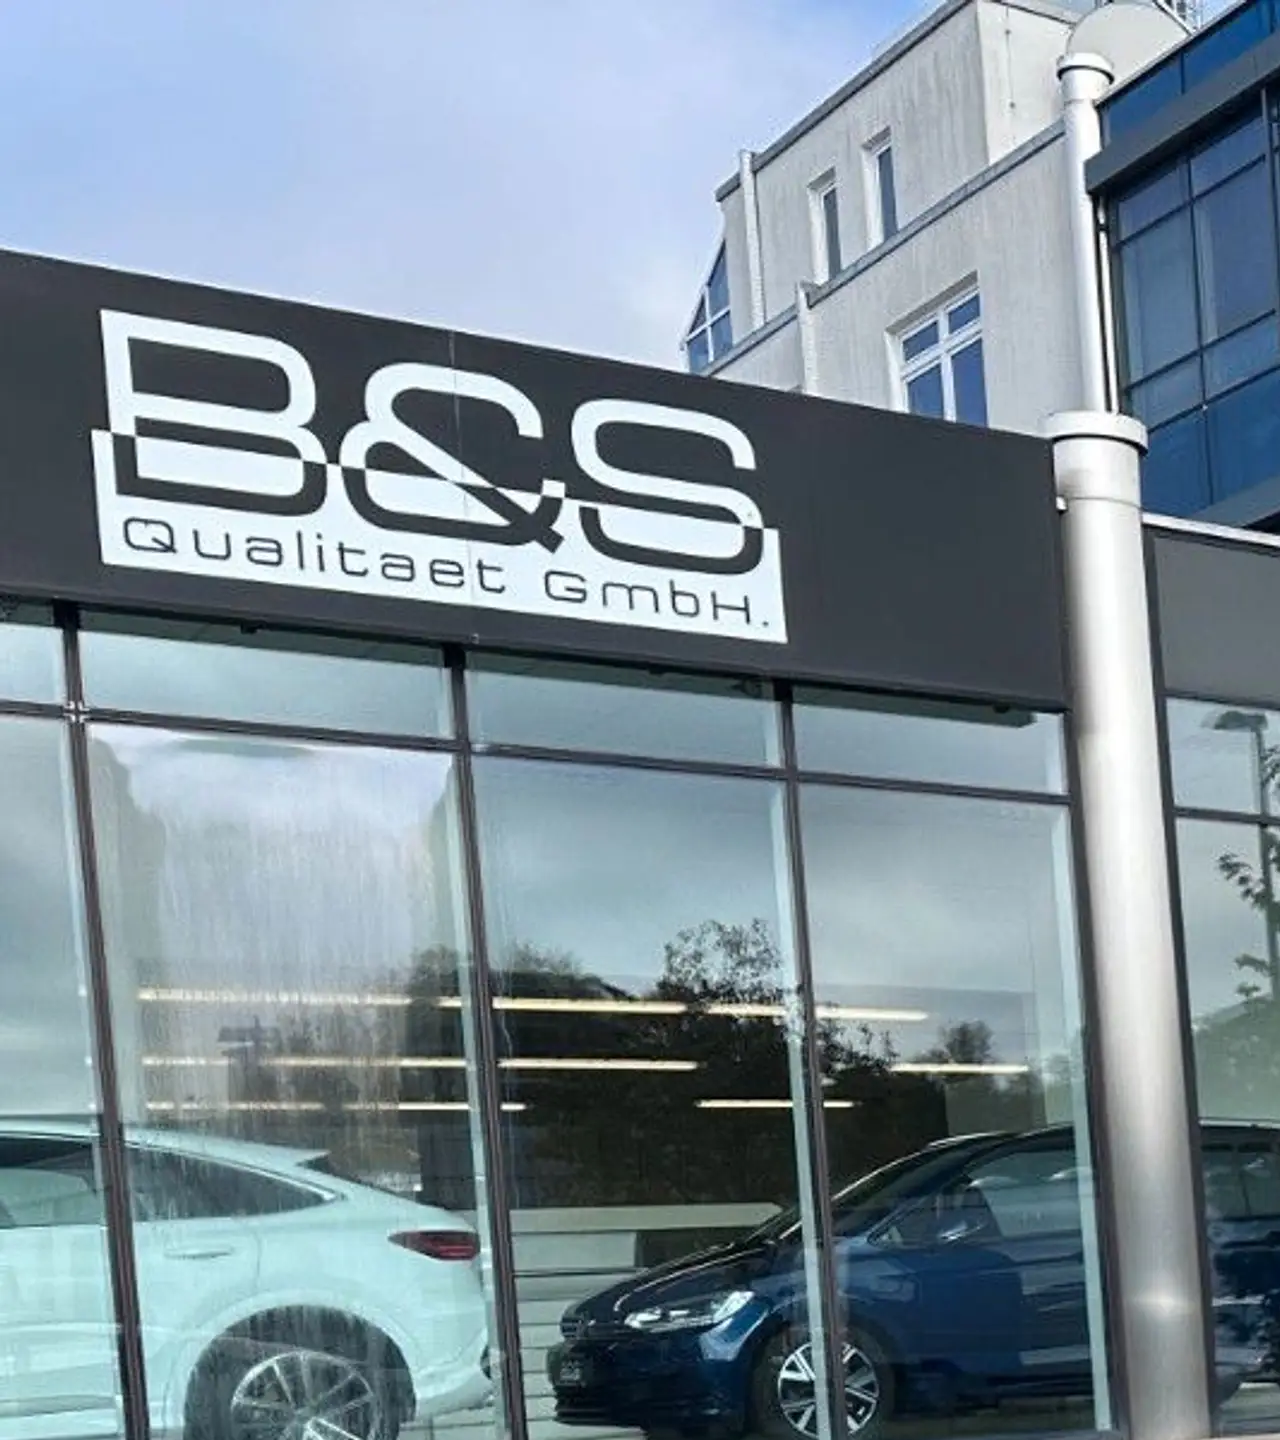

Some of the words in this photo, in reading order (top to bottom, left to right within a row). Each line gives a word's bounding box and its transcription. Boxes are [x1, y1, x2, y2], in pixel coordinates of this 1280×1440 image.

[100, 309, 765, 575] B&S
[123, 516, 507, 596] Qualitaet
[544, 570, 771, 629] GmbH.
